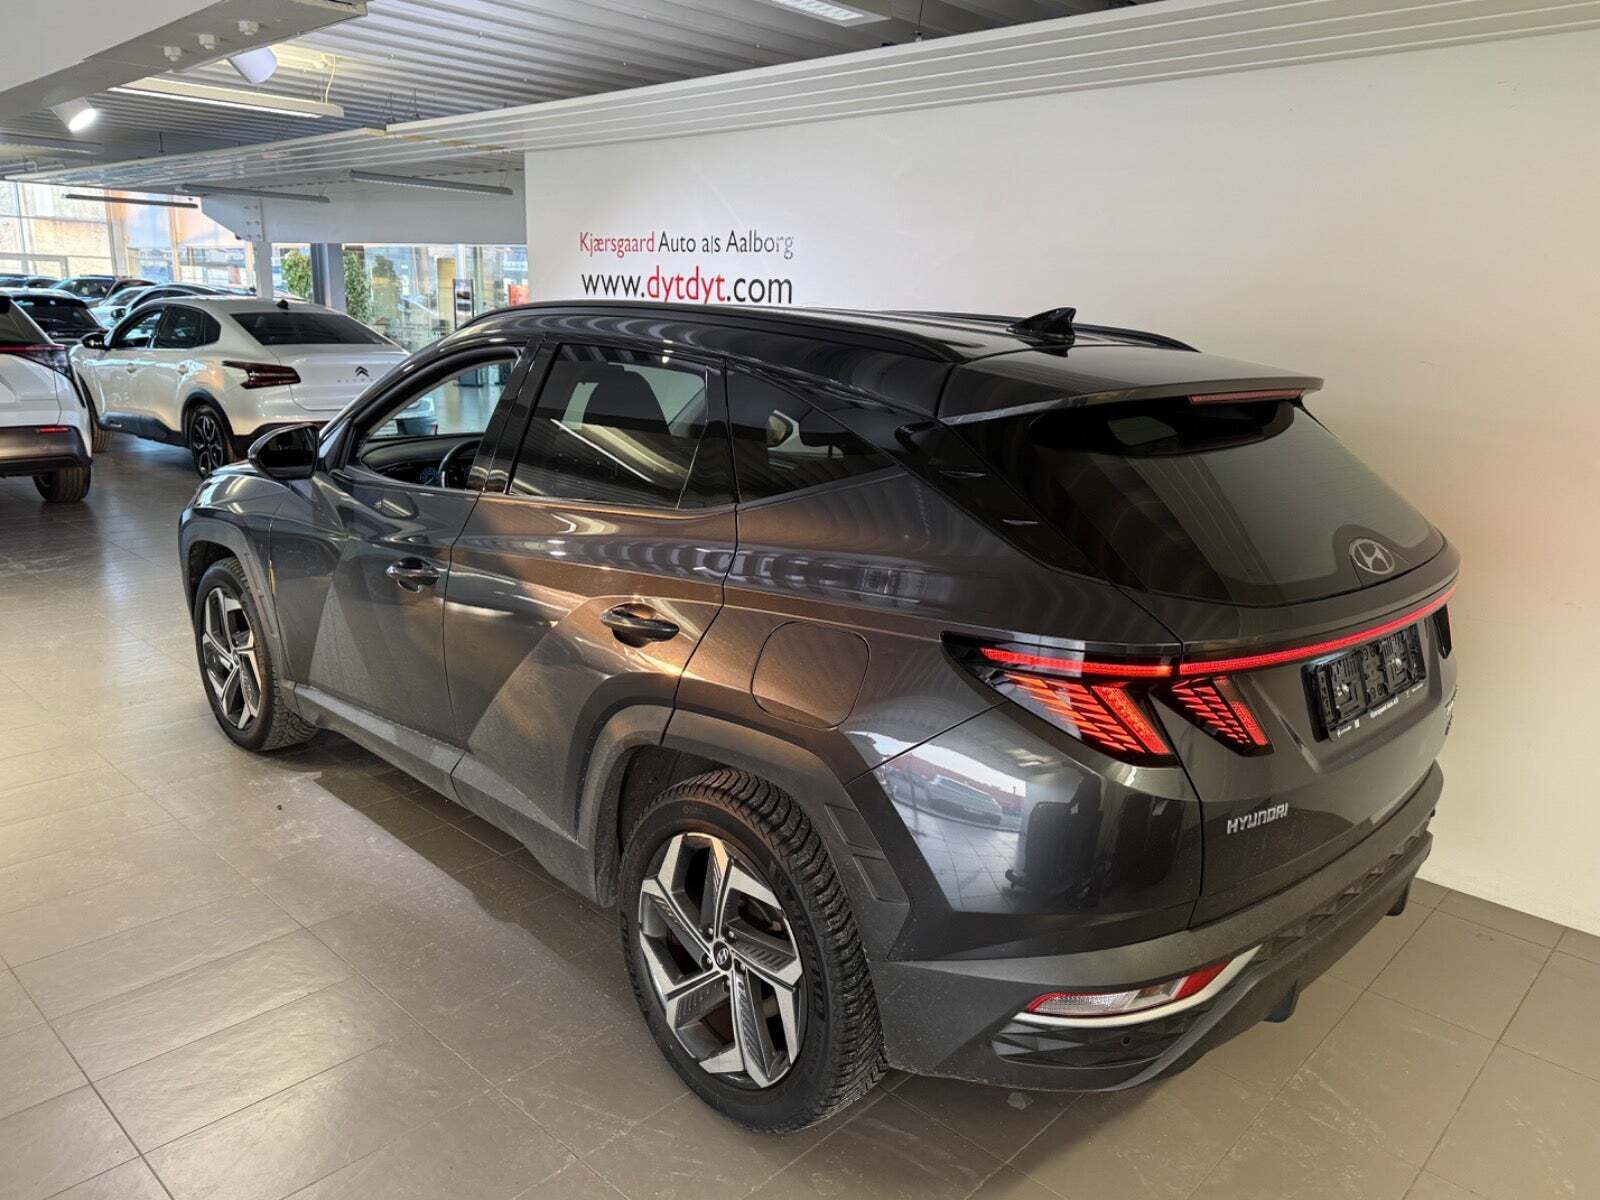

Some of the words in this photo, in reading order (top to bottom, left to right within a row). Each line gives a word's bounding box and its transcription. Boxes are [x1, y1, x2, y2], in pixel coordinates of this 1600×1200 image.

[579, 231, 655, 258] Kjærsgaard
[658, 231, 697, 253] Auto
[726, 229, 794, 260] Aalborg
[581, 265, 793, 304] www.dytdyt.com
[1226, 802, 1289, 835] HYUNDAI
